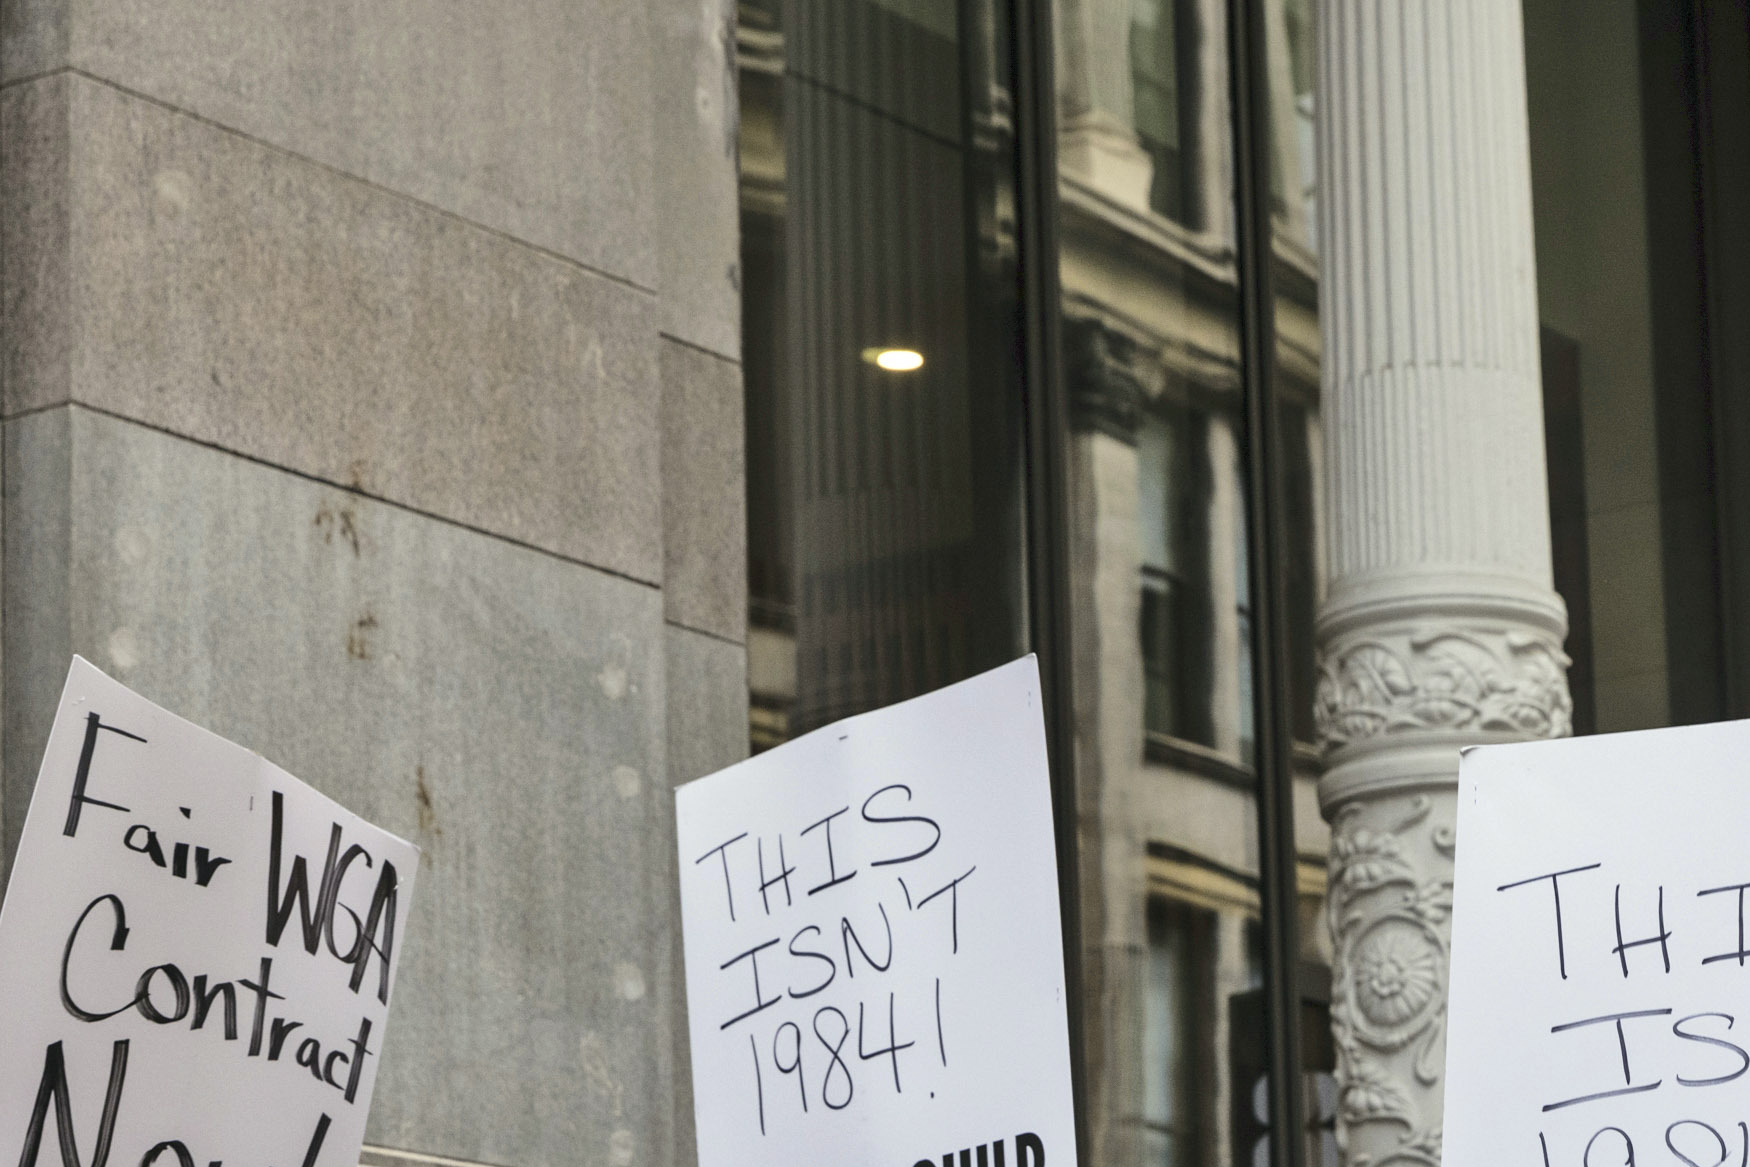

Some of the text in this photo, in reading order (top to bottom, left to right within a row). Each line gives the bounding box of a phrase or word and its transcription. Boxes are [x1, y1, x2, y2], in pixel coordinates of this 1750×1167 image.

[62, 711, 399, 1007] Fair WGA
[695, 784, 941, 922] THIS
[59, 894, 374, 1104] Contract
[720, 865, 977, 1030] ISN'T
[750, 977, 947, 1136] 1984!
